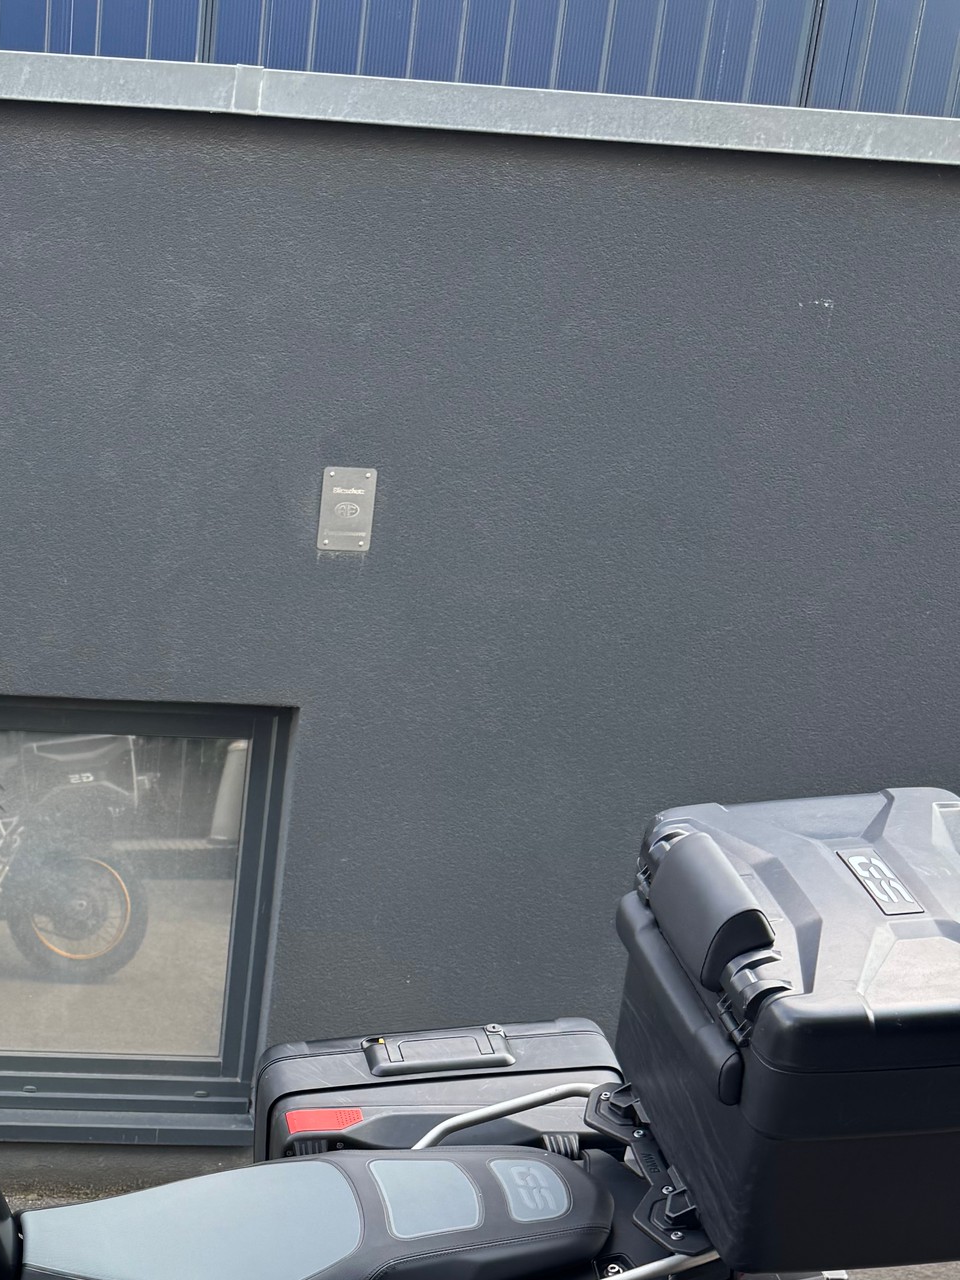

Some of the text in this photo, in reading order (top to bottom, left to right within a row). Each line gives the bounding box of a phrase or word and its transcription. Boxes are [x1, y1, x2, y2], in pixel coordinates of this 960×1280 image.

[847, 856, 915, 903] GS
[641, 1152, 660, 1173] BMW
[510, 1166, 558, 1210] GS
